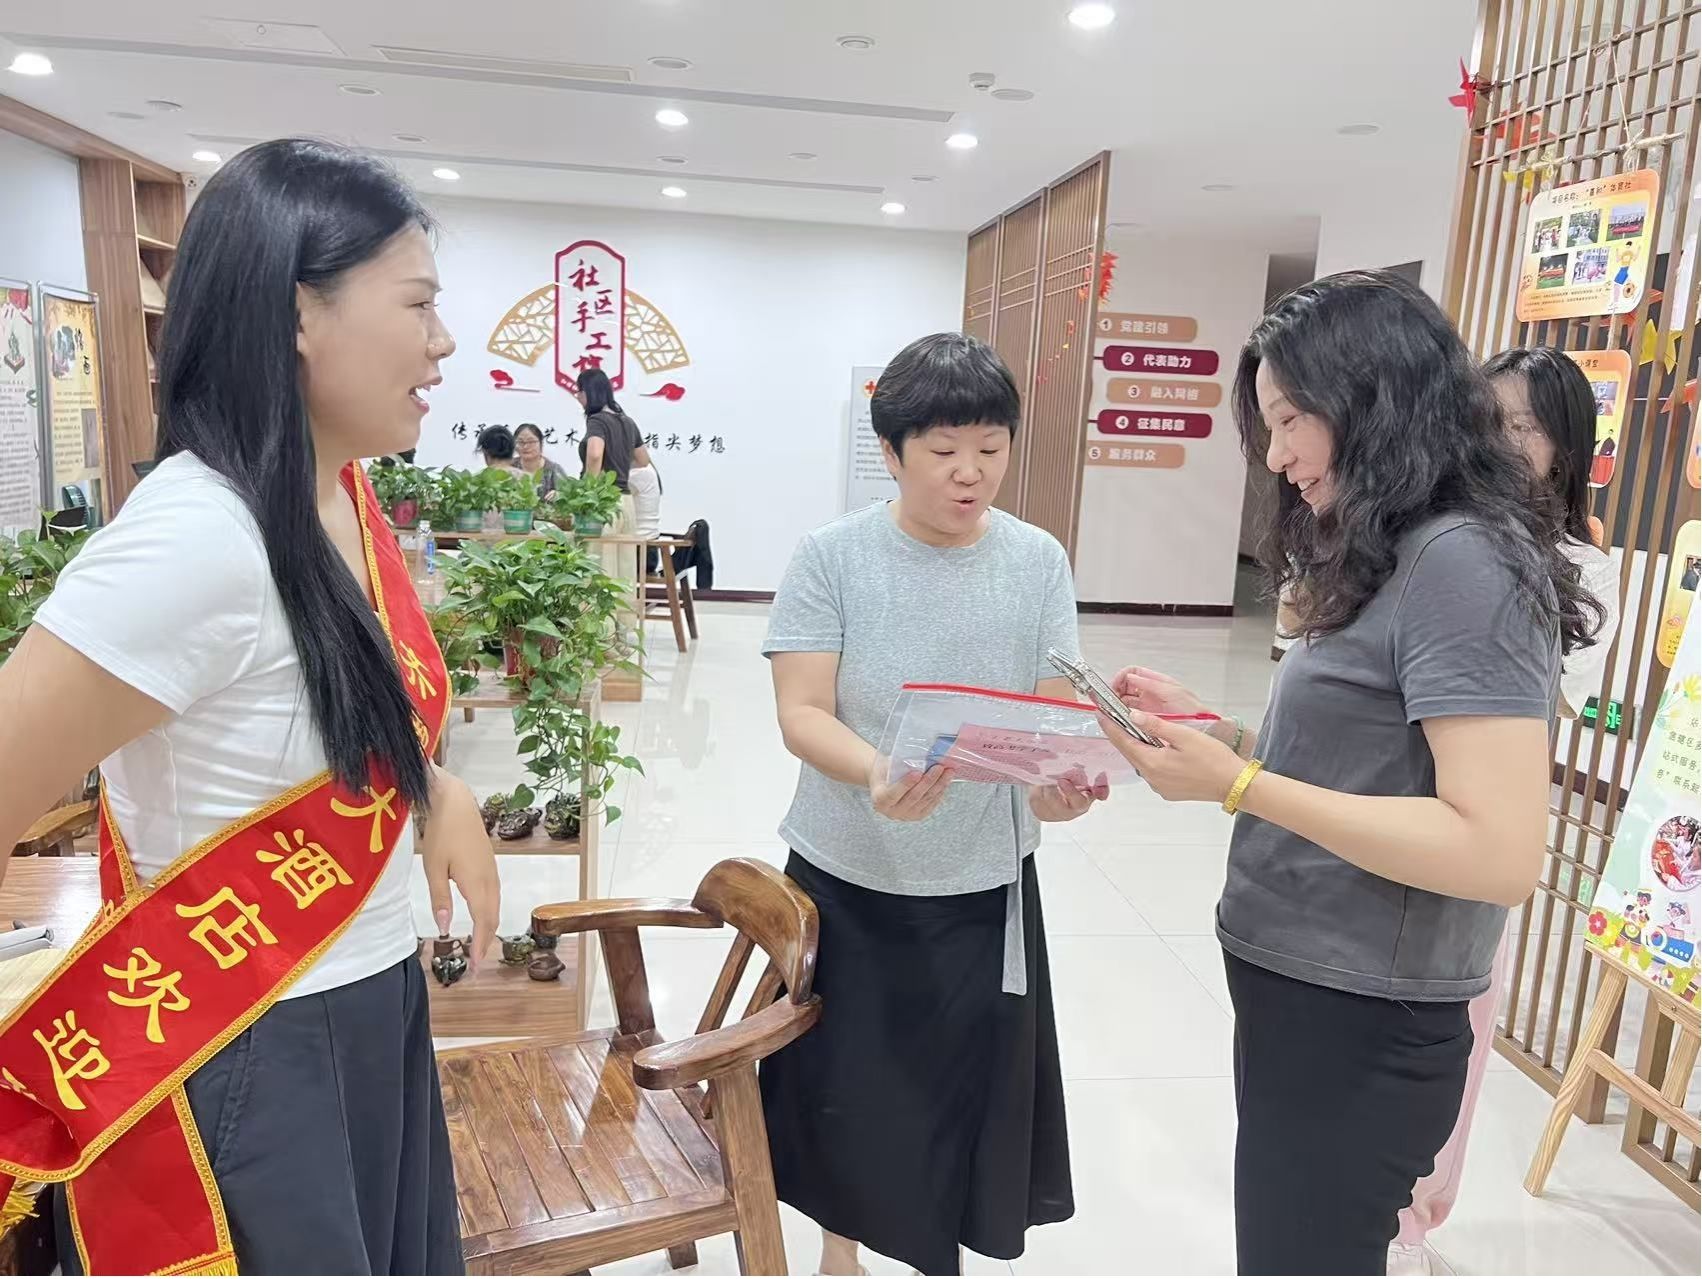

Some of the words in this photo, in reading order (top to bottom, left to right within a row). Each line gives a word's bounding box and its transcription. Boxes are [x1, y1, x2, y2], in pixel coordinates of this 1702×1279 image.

[1143, 354, 1192, 368] 代表助力
[1137, 417, 1186, 431] 征集民意
[0, 785, 397, 1110] 大酒店欢迎
